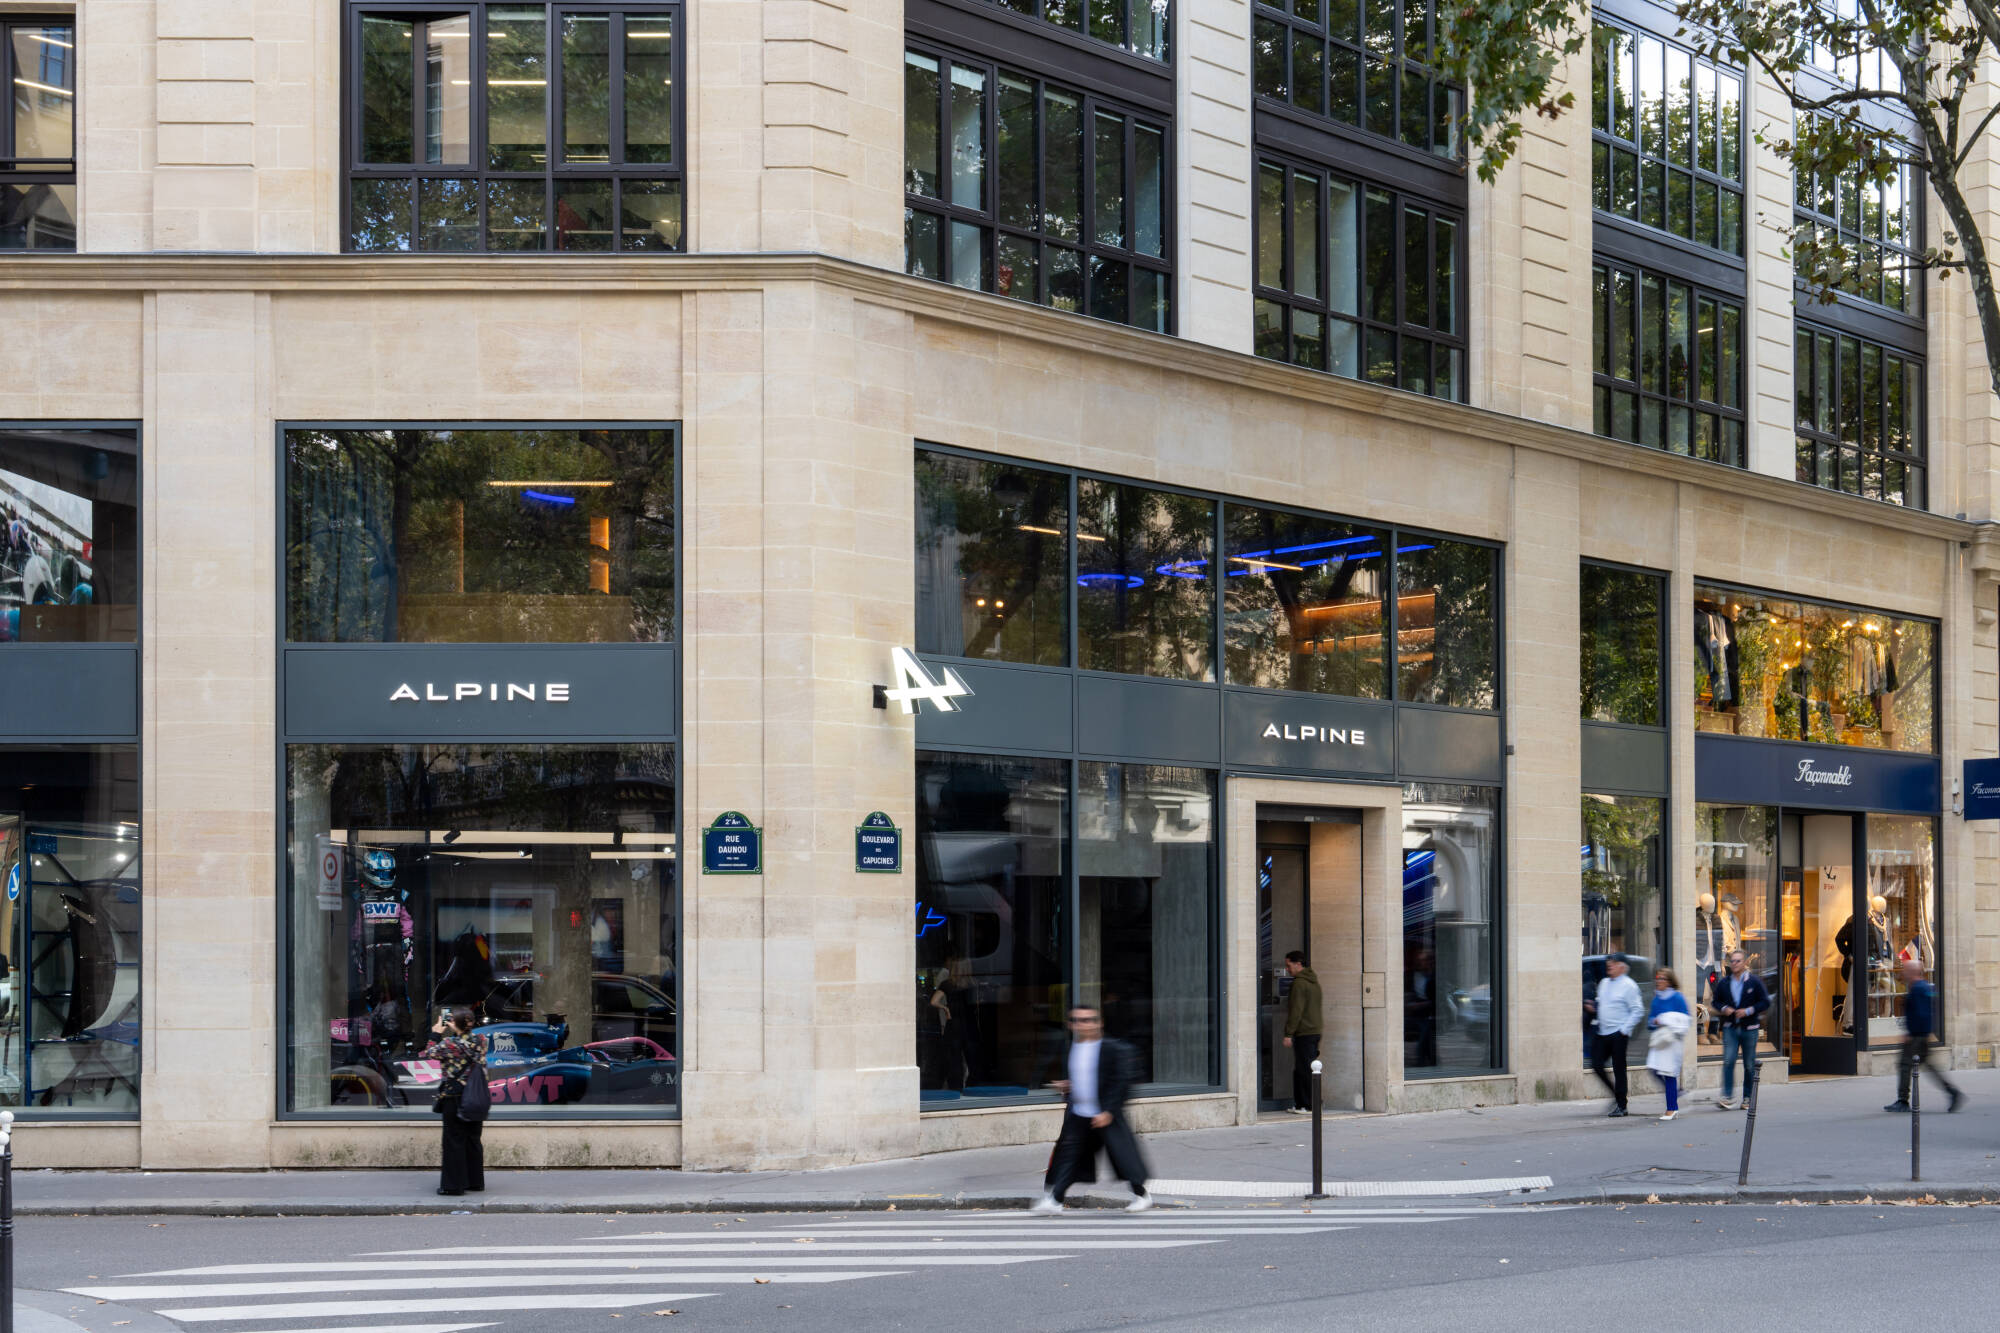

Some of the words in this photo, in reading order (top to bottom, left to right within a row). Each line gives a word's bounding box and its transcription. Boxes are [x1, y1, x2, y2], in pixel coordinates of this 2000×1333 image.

[389, 683, 570, 702] ALPINE
[1262, 722, 1366, 745] ALPINE
[1795, 759, 1852, 786] Façonnable
[725, 835, 740, 843] RUE
[862, 835, 895, 844] BOULEVARD
[718, 846, 747, 854] DAUNOU
[862, 856, 894, 865] CAPUCINES
[364, 903, 397, 914] BWT
[487, 1075, 563, 1103] BWT
